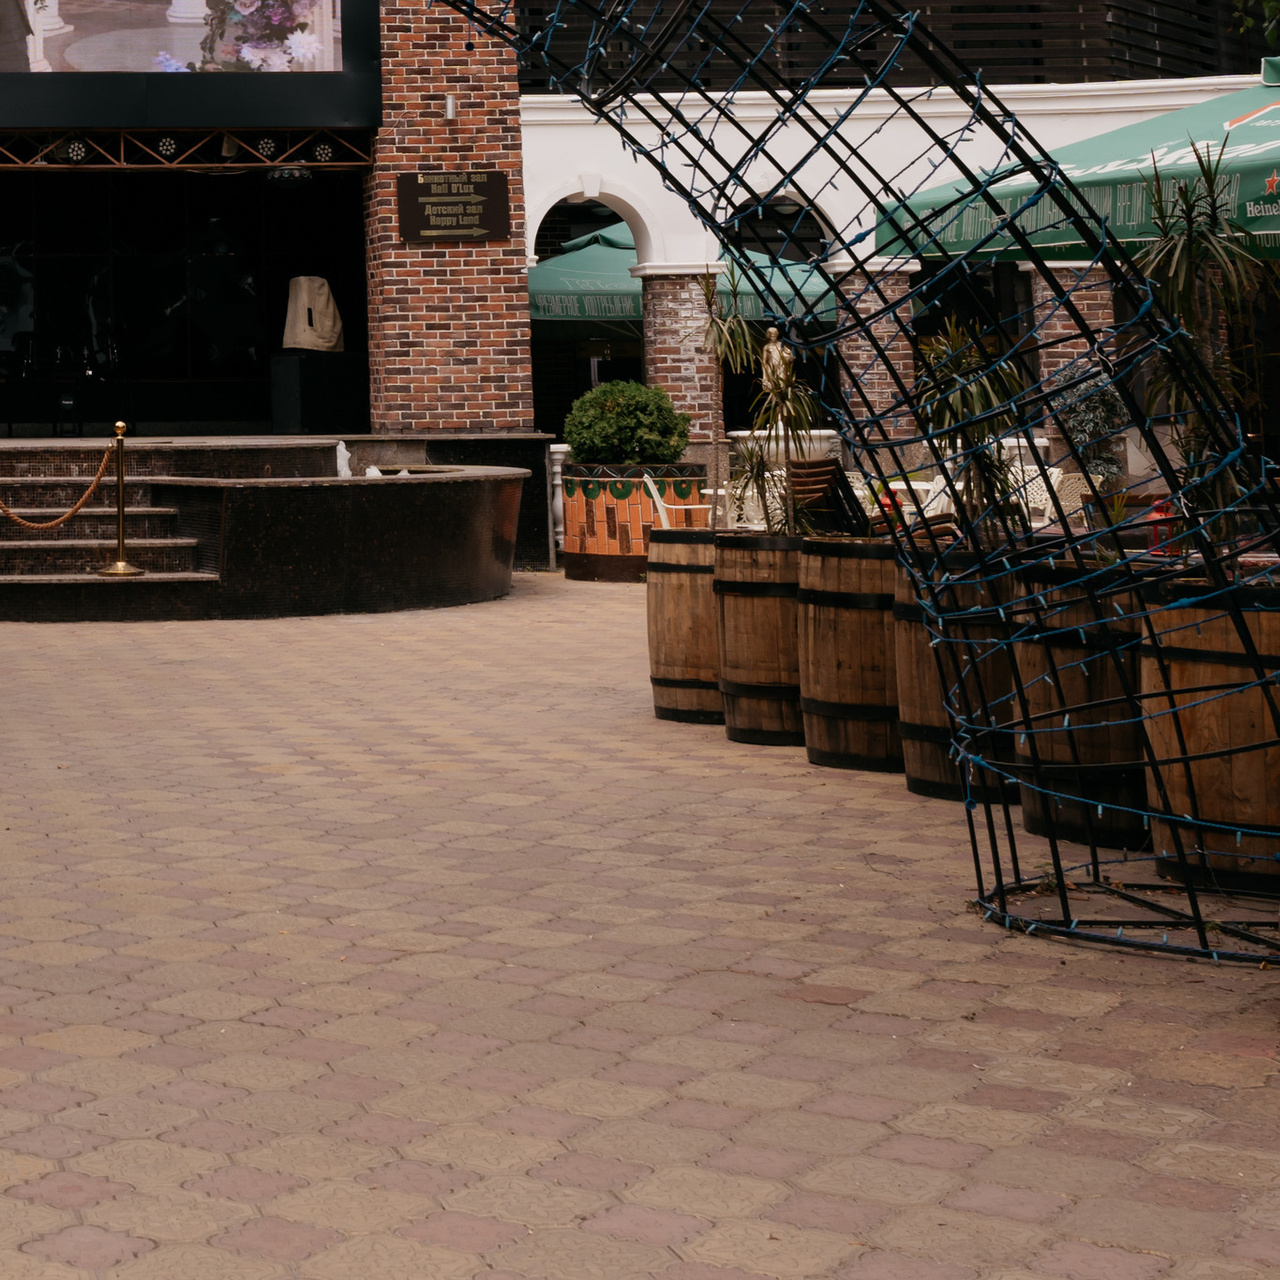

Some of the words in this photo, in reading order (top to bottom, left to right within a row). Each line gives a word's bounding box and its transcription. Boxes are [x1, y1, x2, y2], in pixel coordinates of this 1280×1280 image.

[470, 173, 488, 182] зал
[431, 183, 449, 194] Hall
[424, 203, 464, 216] Детский
[466, 204, 483, 214] зал
[429, 216, 457, 227] Happy
[459, 215, 480, 225] Land
